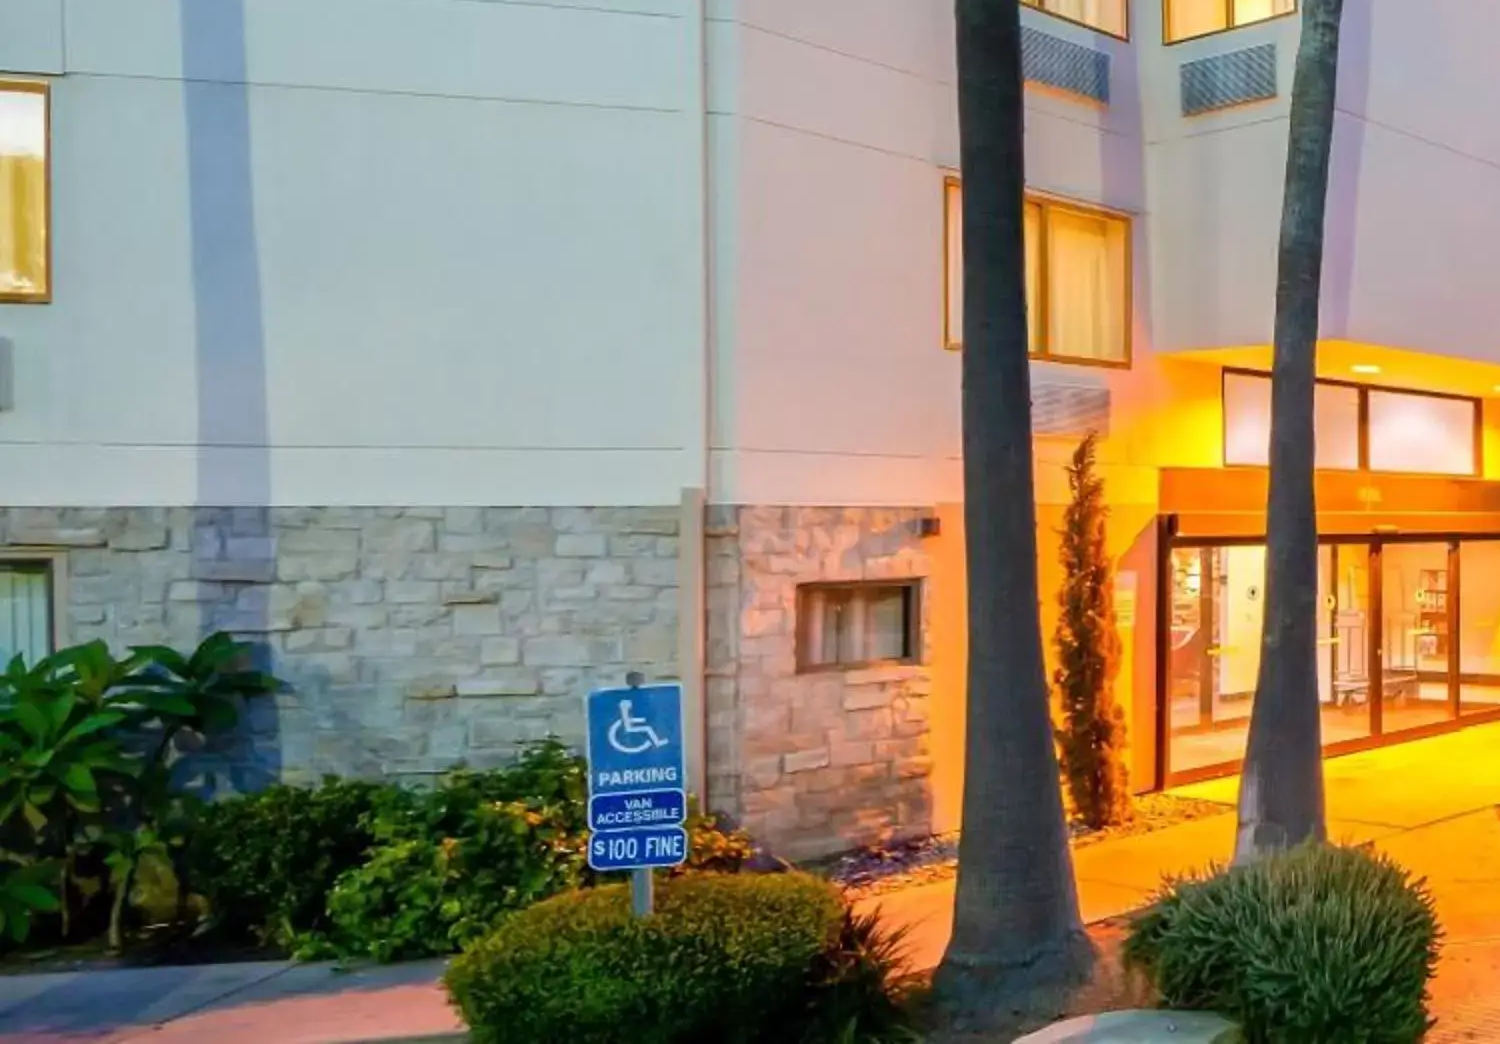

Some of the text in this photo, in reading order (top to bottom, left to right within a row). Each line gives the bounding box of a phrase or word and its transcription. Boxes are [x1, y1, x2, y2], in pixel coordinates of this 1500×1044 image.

[599, 767, 677, 786] PARKING
[624, 798, 652, 809] VAN
[596, 807, 680, 824] ACCESSIBLE
[645, 835, 683, 859] FINE
